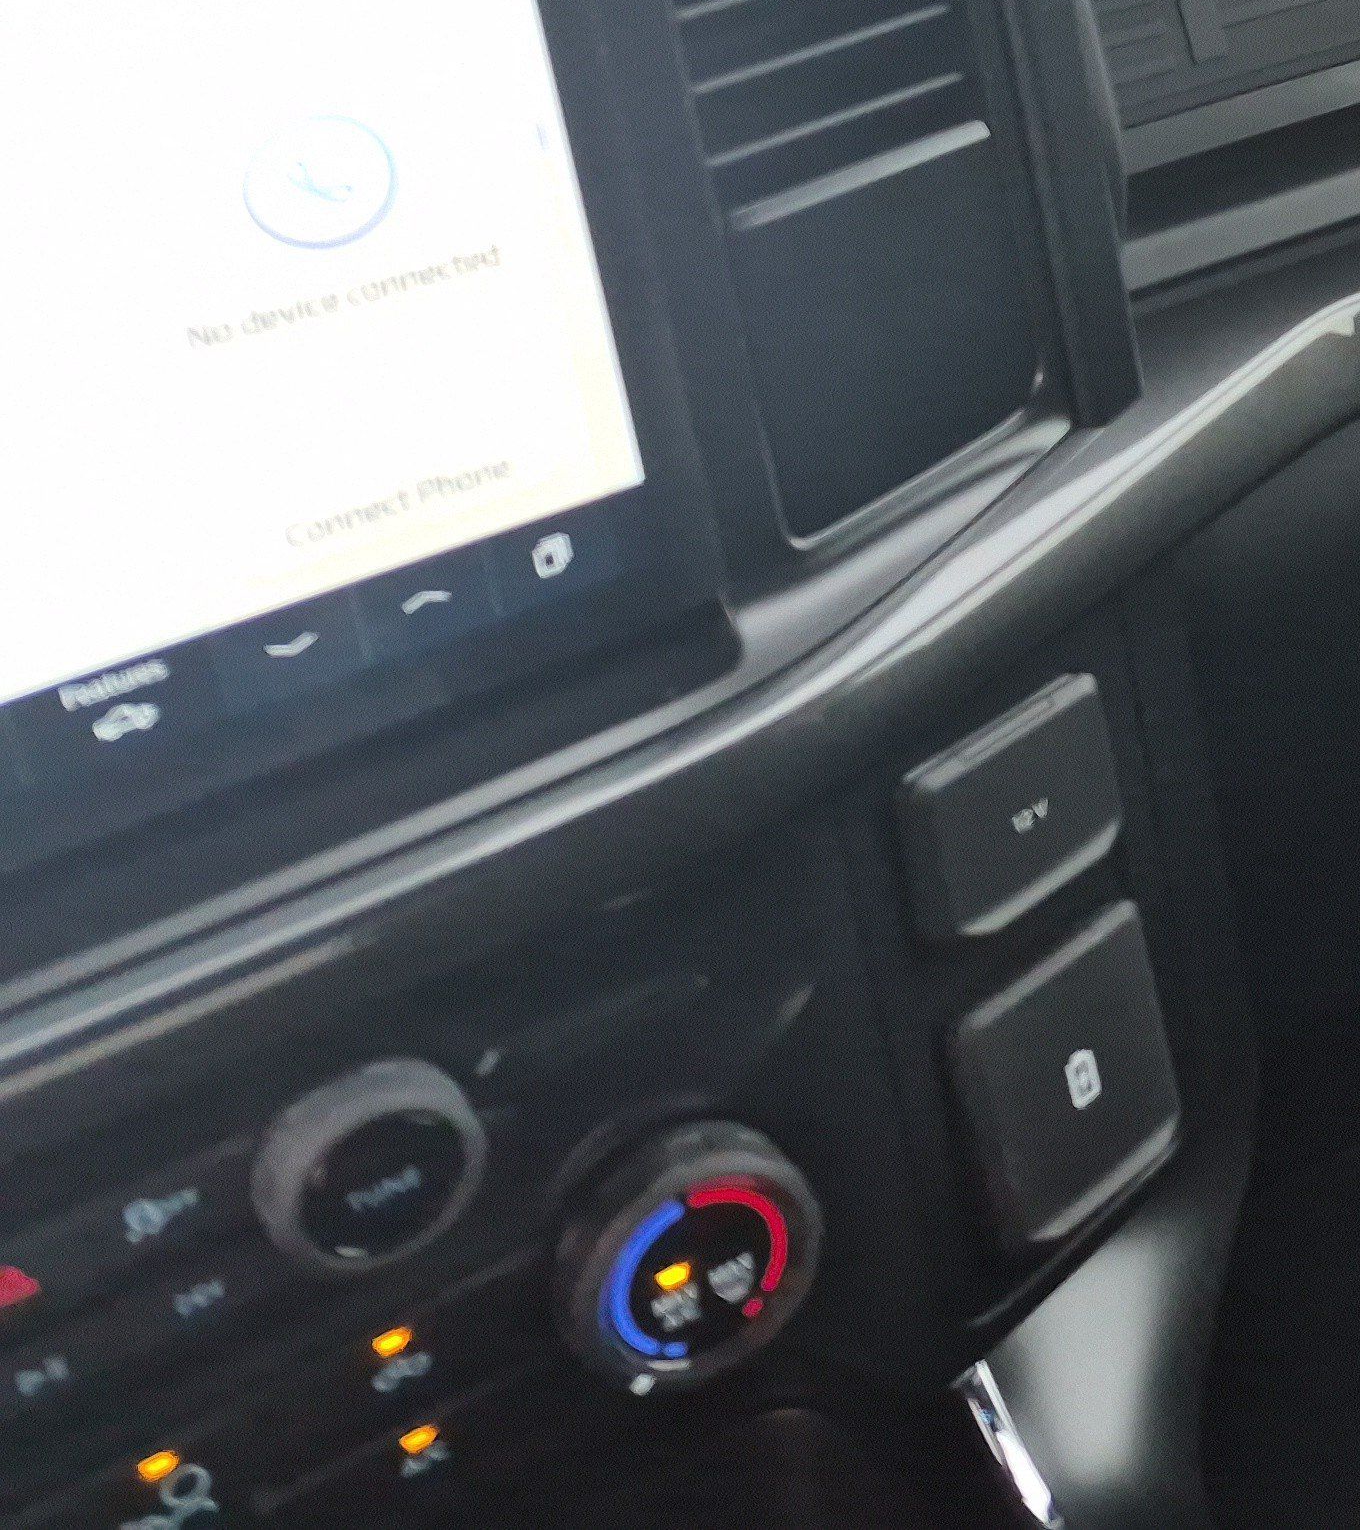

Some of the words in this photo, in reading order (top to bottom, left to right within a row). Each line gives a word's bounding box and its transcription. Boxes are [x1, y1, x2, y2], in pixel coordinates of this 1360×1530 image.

[187, 321, 234, 349] No
[241, 292, 340, 336] device
[347, 245, 503, 310] connected
[285, 490, 410, 548] Connect
[416, 459, 511, 503] Phone
